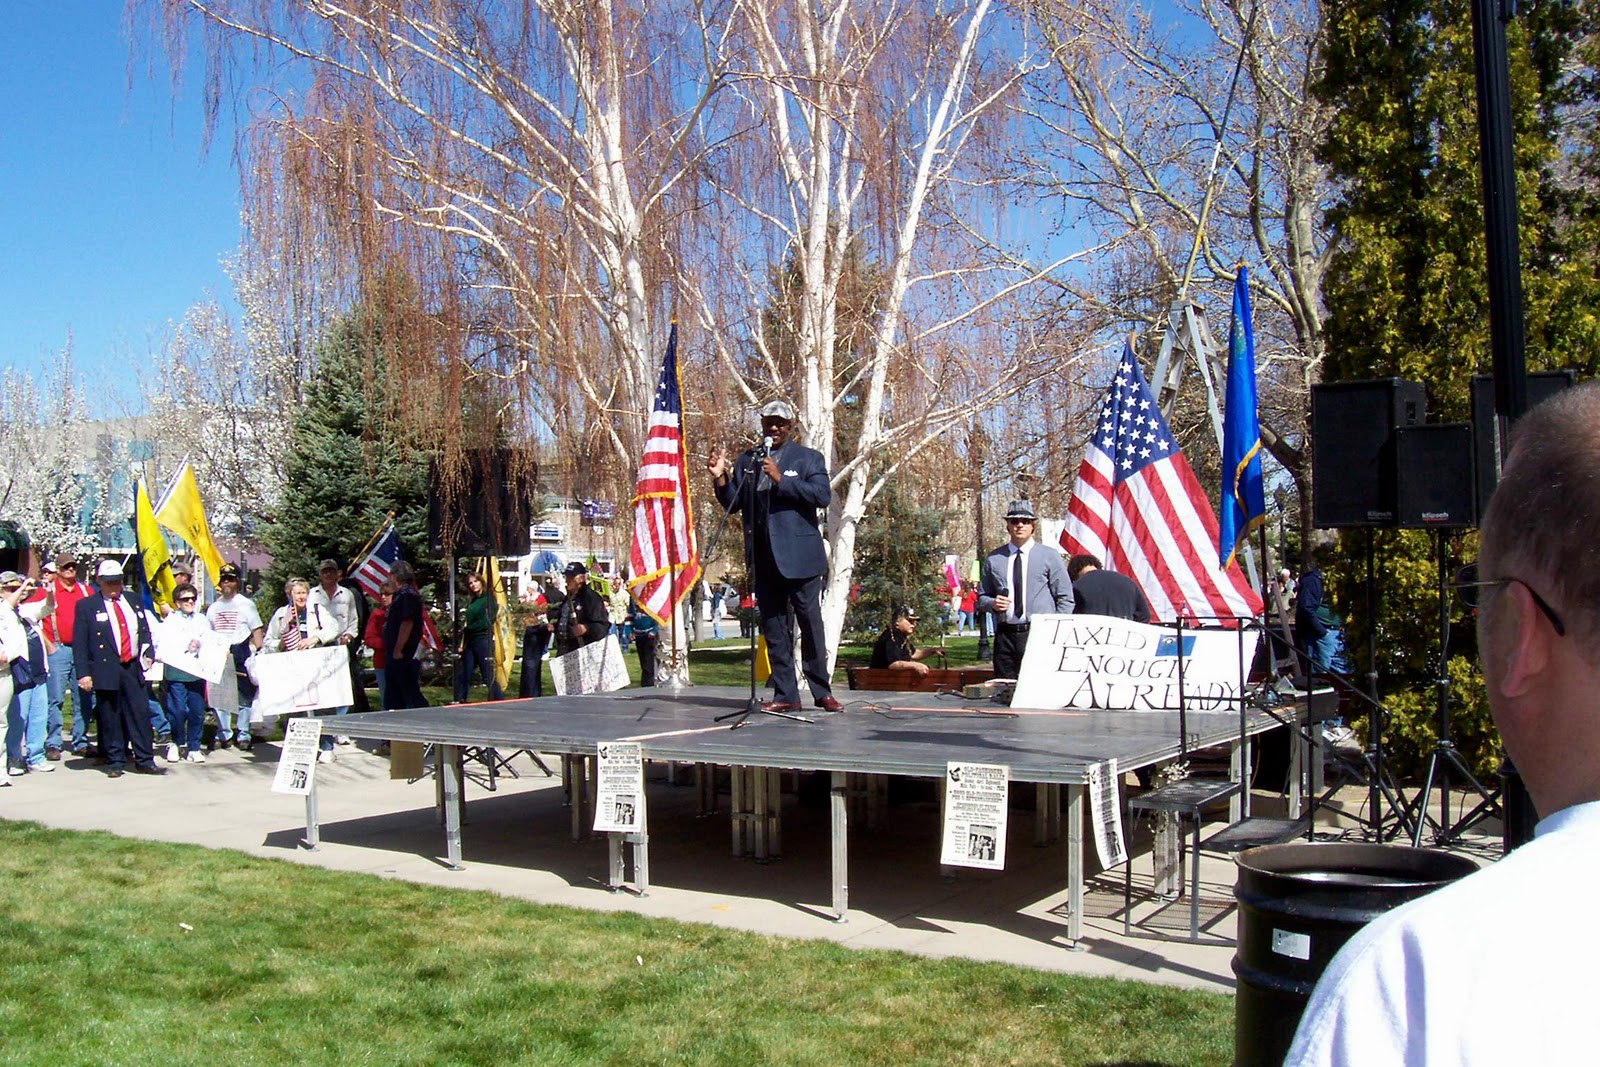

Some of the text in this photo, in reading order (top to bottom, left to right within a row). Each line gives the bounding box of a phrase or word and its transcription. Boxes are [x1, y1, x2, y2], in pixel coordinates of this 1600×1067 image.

[1044, 618, 1147, 650] TAXED
[1056, 646, 1192, 679] ENOUGH
[1062, 673, 1241, 712] ALREADY
